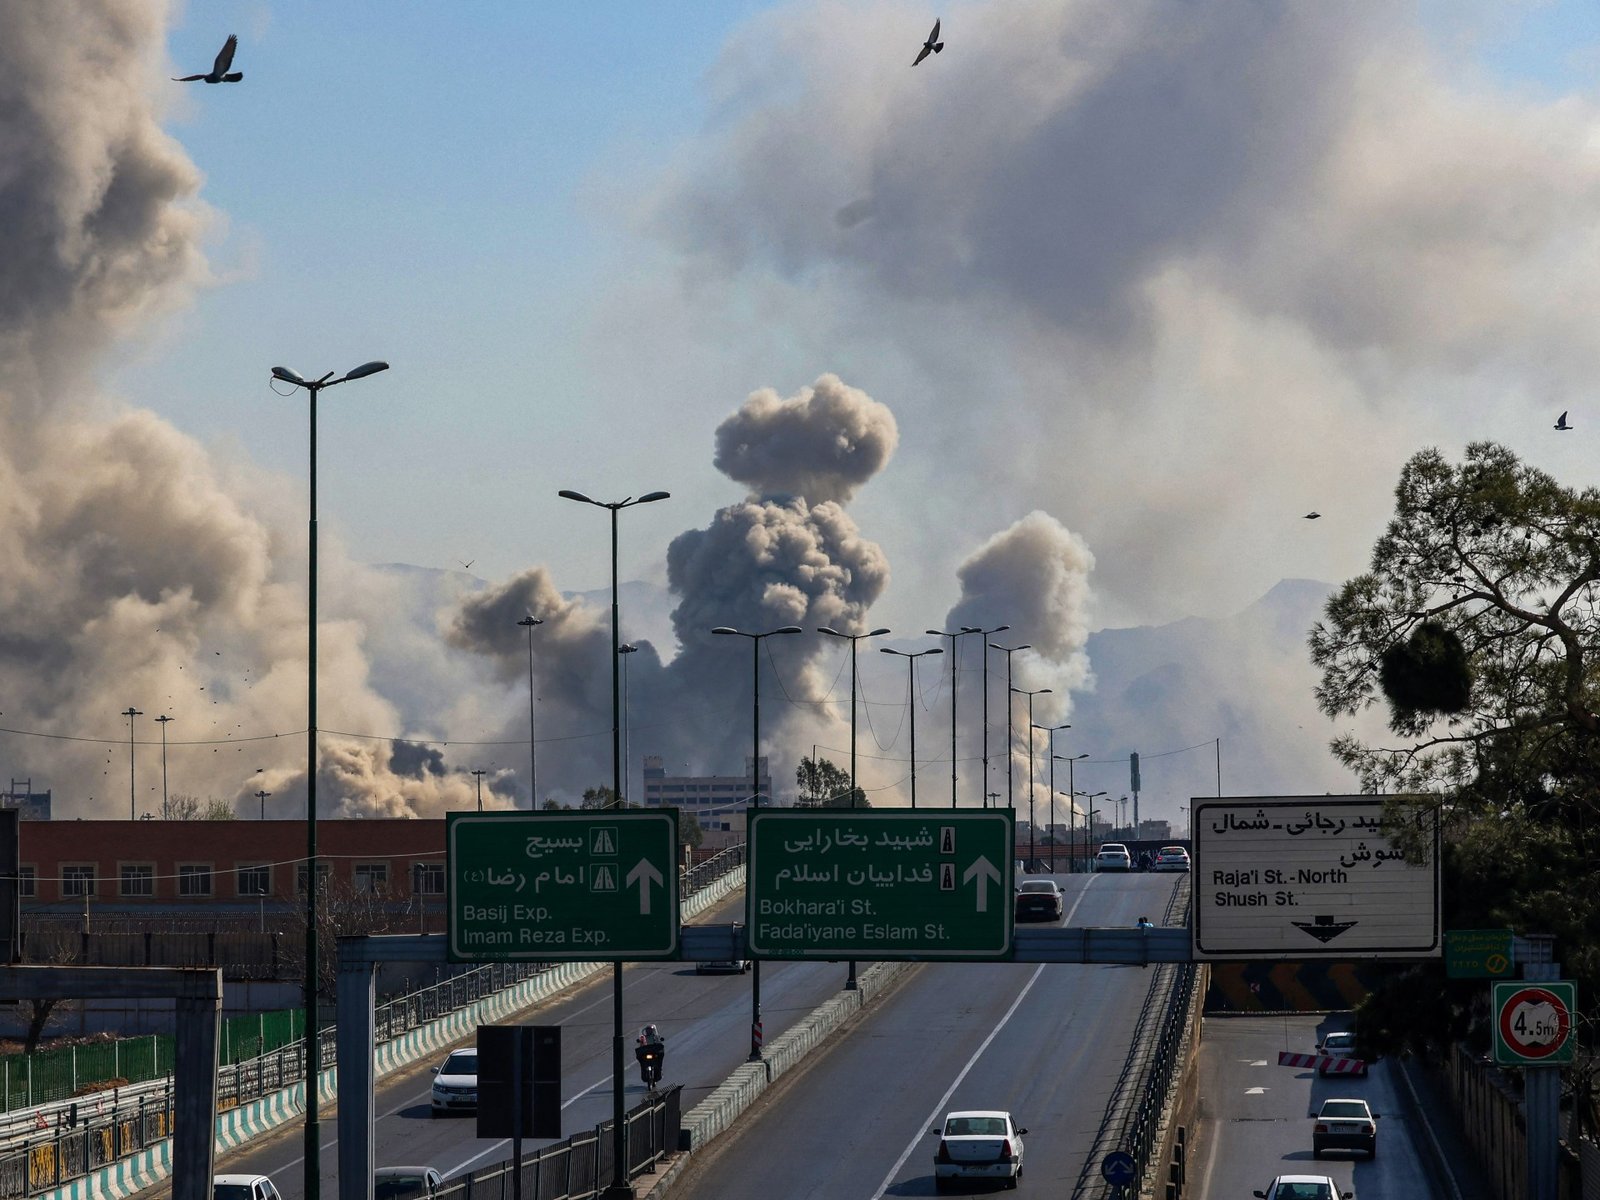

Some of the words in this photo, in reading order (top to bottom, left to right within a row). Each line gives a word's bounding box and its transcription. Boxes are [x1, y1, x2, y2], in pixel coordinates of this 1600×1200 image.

[526, 836, 583, 858] بسیج
[784, 828, 869, 854] بخارایی
[874, 826, 934, 851] شهید
[535, 866, 584, 894] امام
[775, 864, 839, 891] اسلام
[846, 862, 933, 888] فداییان
[1213, 870, 1259, 887] Raja'i
[760, 899, 845, 915] Bokhara'i
[851, 899, 877, 915] St.
[1214, 891, 1268, 907] Shush
[1274, 890, 1299, 906] St.
[463, 905, 508, 924] Basij
[513, 904, 553, 923] Exp.
[463, 928, 513, 945] Imam
[519, 928, 566, 944] Reza
[571, 927, 611, 946] Exp.
[759, 923, 857, 943] Fada'iyane
[863, 923, 918, 940] Eslam
[924, 923, 950, 940] St.
